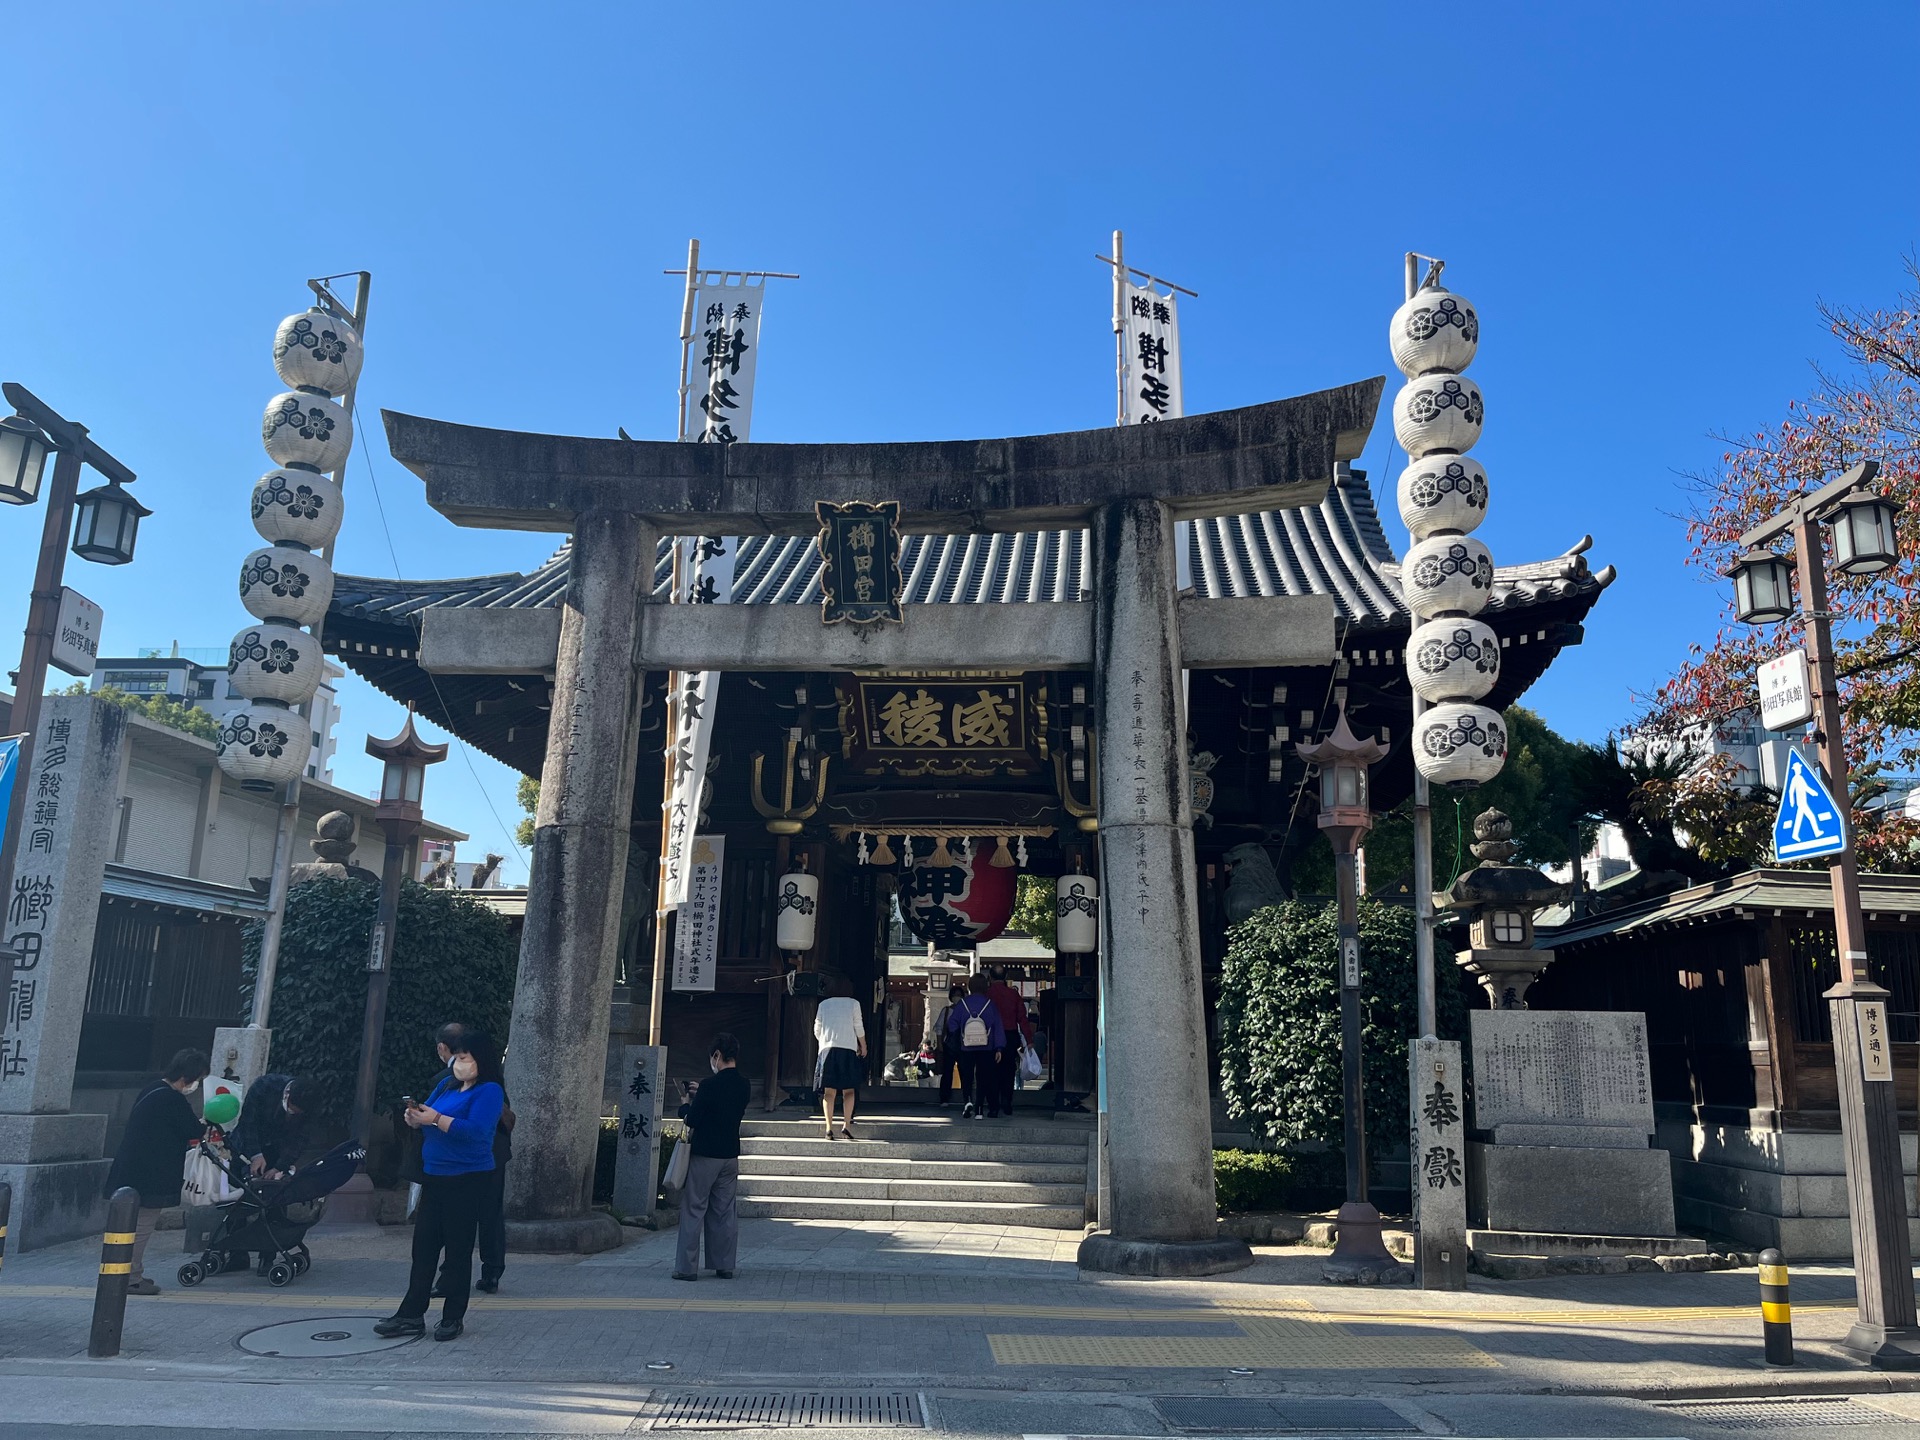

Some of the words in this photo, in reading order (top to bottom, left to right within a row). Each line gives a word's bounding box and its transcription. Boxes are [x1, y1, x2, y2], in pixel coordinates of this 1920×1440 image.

[847, 522, 876, 603] 櫛田宮
[62, 626, 98, 659] 杉田写真館
[75, 615, 90, 631] 博多
[1762, 685, 1803, 714] 杉田写真館
[1772, 675, 1788, 690] 博多
[694, 866, 706, 908] 第四十九回
[705, 864, 718, 963] うけつぐ博多のこころ
[688, 911, 703, 984] 櫛田神社式年遷宮
[1866, 1008, 1881, 1067] 博多通り
